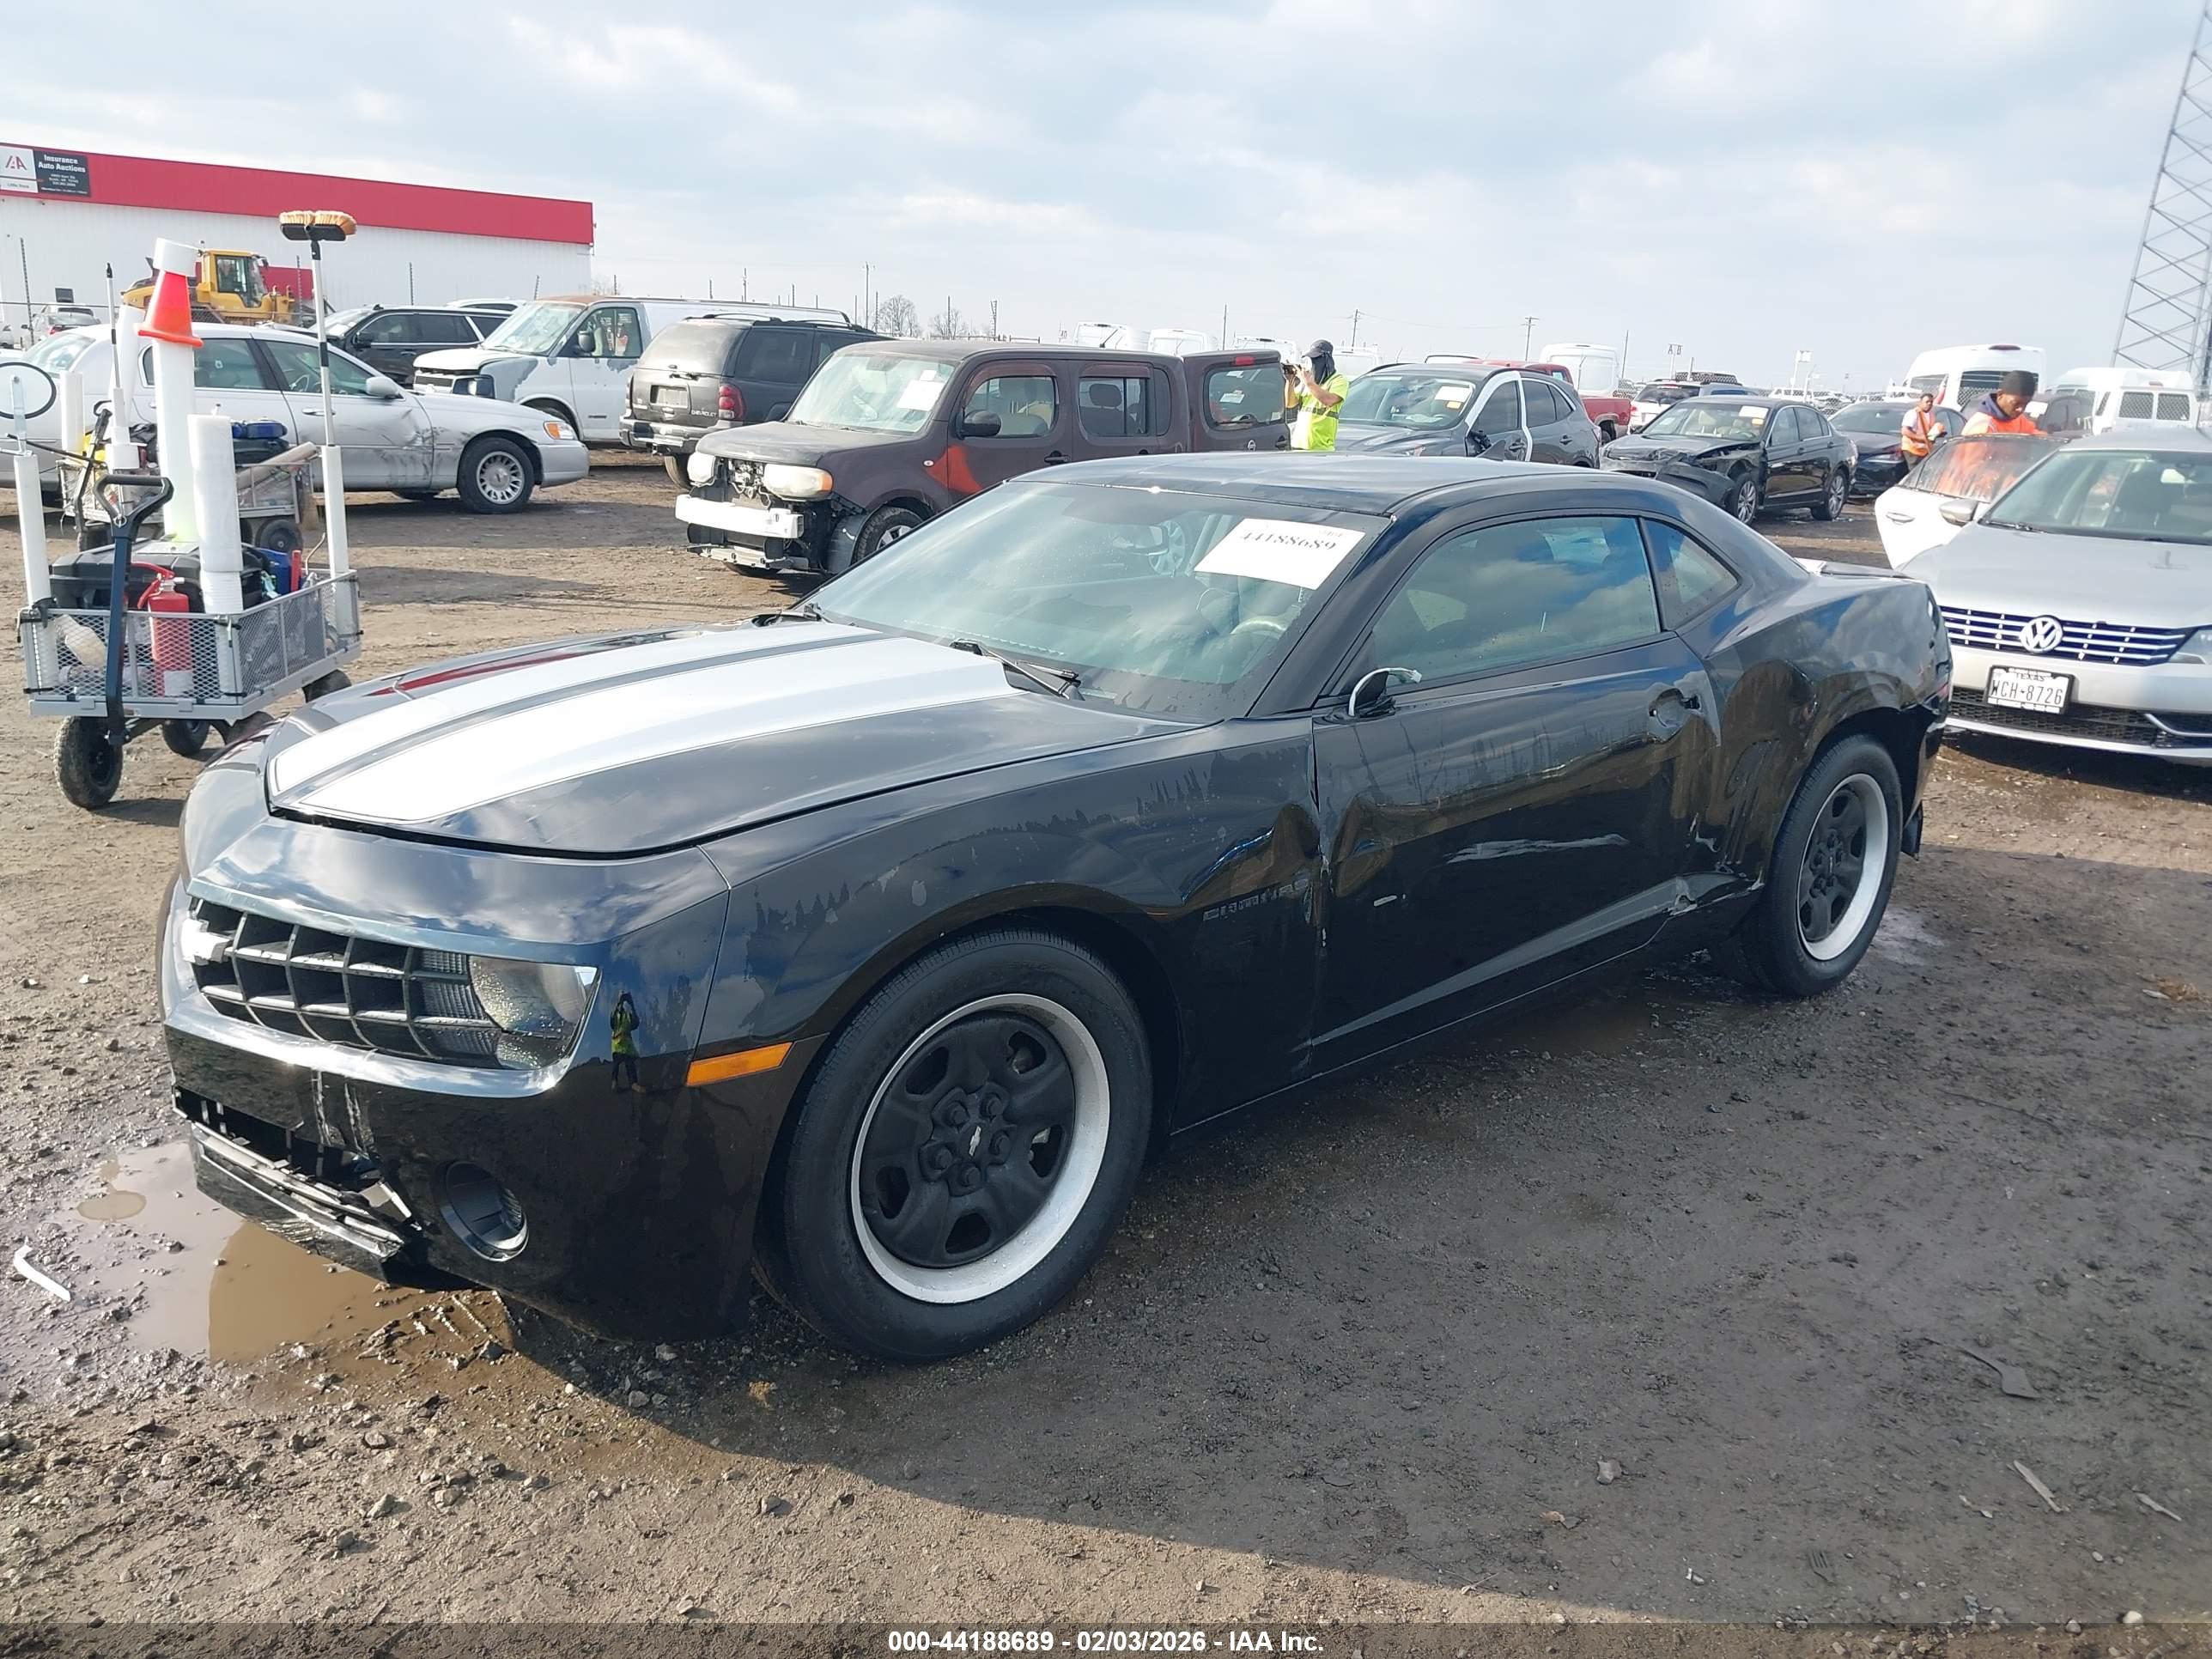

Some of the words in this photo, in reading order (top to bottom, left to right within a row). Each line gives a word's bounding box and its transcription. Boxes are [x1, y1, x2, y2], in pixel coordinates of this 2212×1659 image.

[44, 154, 78, 165] Insurance
[38, 161, 55, 170] Auto
[56, 163, 86, 173] Auctions
[1240, 531, 1337, 550] 44188689
